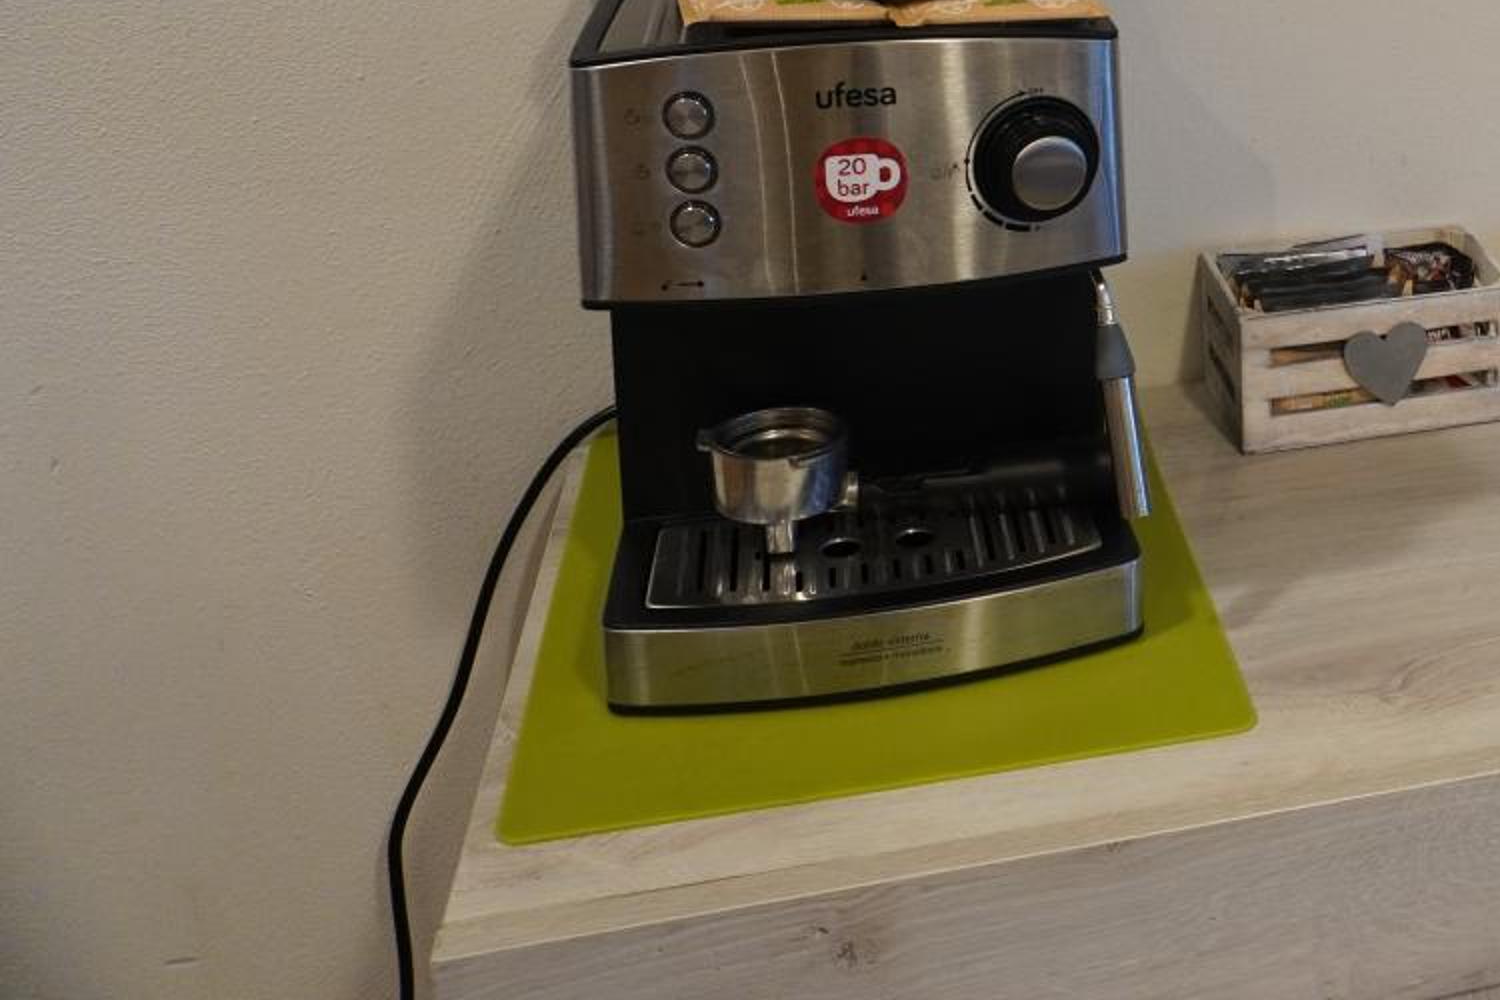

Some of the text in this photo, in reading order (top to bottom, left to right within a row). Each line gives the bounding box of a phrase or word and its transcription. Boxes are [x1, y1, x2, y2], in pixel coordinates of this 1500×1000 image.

[815, 80, 898, 110] ufesa
[836, 156, 868, 178] 20
[836, 177, 871, 199] bar
[846, 203, 880, 218] ufesa
